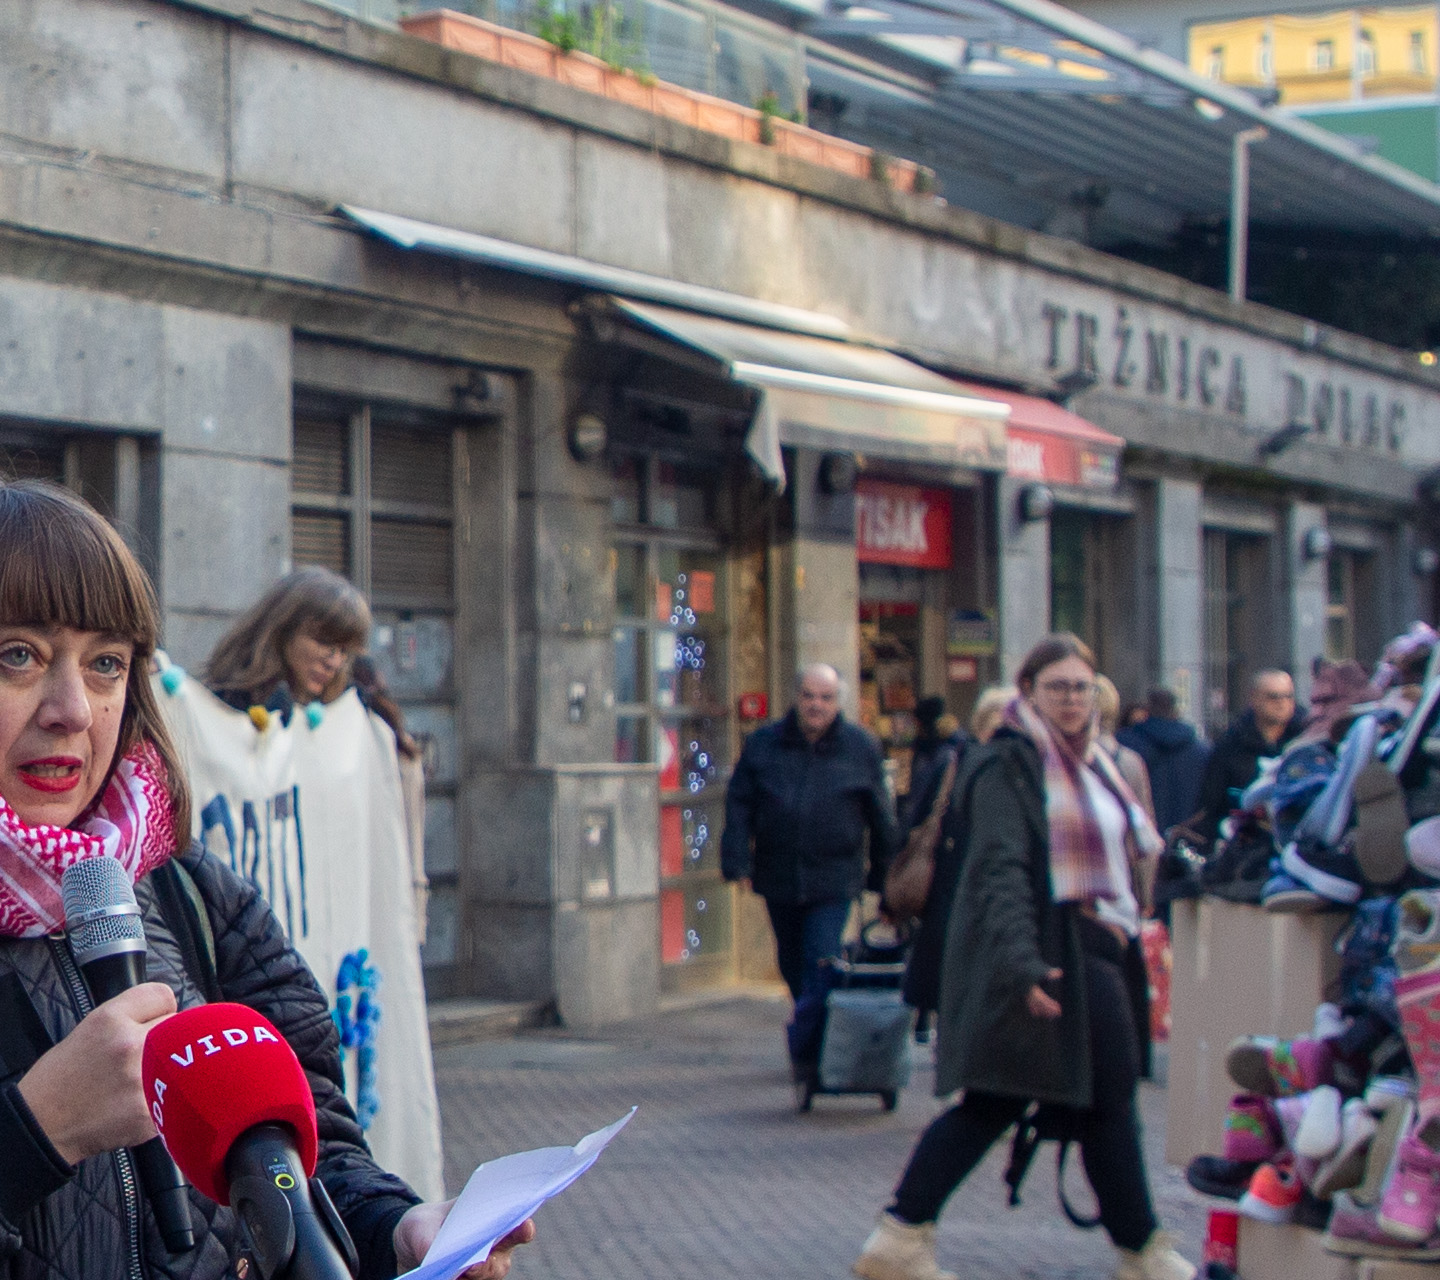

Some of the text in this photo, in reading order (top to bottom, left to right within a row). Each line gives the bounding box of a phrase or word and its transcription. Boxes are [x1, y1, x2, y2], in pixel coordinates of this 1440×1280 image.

[1040, 300, 1408, 453] TRŽNICA DOLAC
[170, 1026, 279, 1067] VIDA
